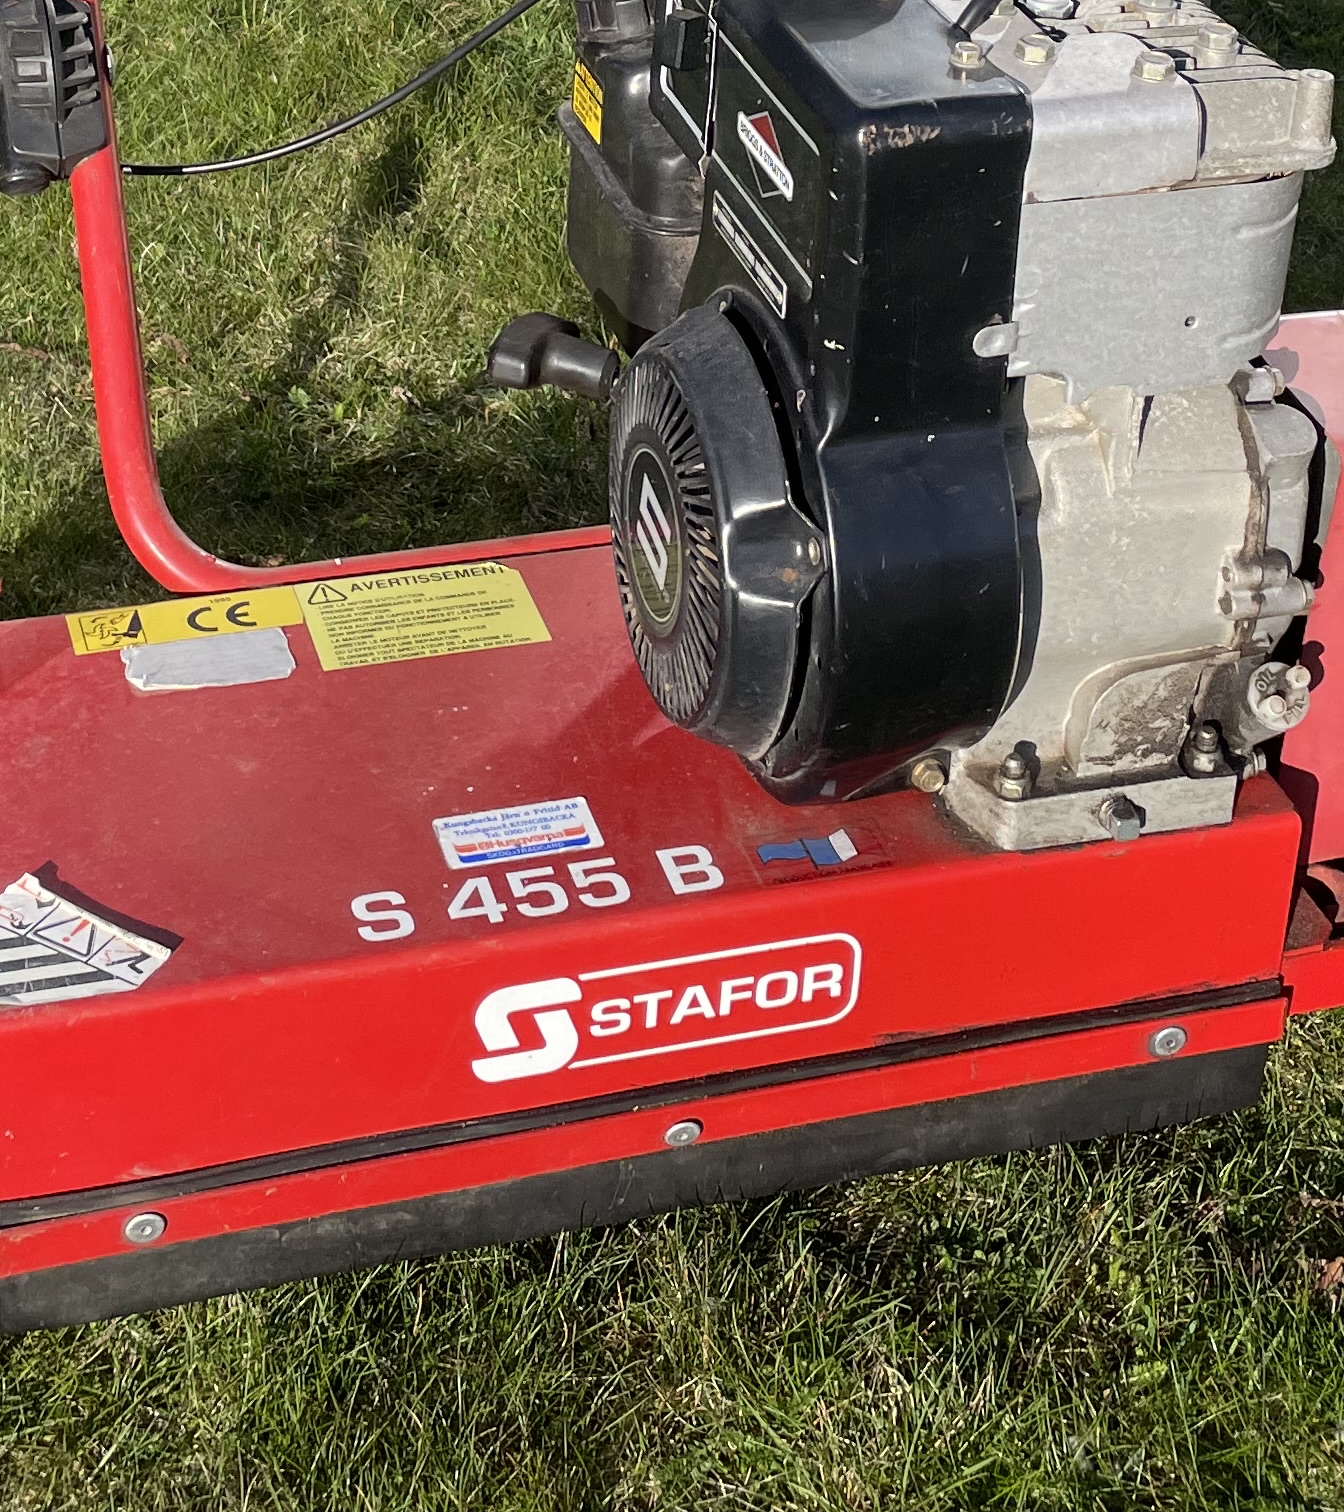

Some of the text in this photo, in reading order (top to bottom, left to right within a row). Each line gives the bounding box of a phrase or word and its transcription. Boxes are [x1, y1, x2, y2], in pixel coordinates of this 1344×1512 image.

[186, 600, 258, 632] CE
[1255, 669, 1276, 692] OIL
[443, 814, 497, 829] Kungsbacka
[510, 812, 575, 828] KUNGSBACKA
[488, 829, 563, 850] Husqvarna
[350, 845, 725, 942] S 455 B
[589, 963, 845, 1038] STAFOR
